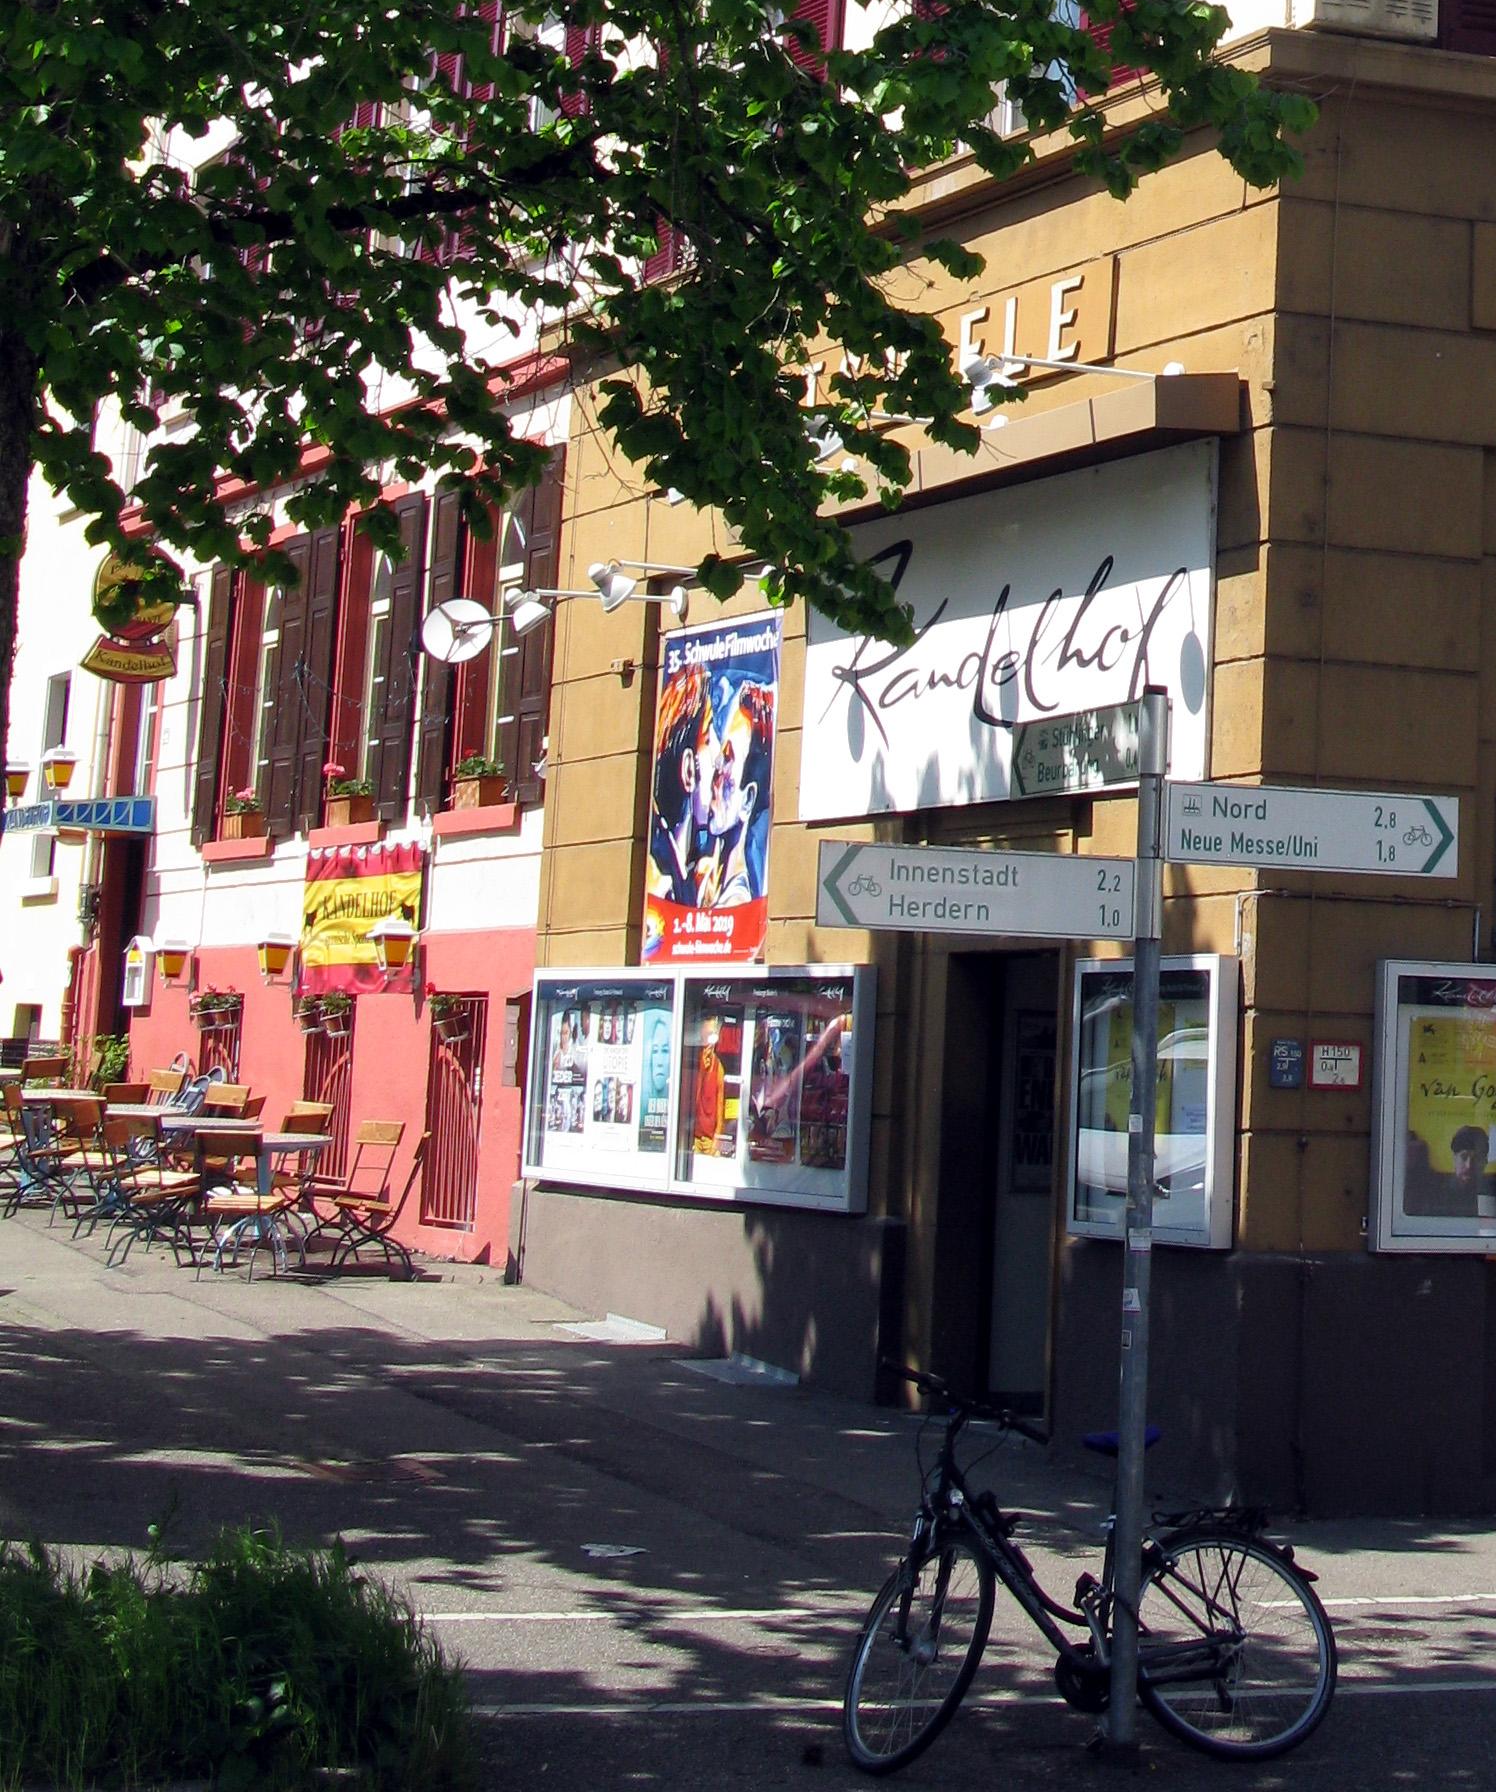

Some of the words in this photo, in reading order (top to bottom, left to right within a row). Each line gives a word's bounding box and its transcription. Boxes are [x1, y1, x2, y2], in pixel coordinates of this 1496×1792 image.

[684, 635, 725, 665] Schwule
[725, 625, 780, 658] Filmwoche
[818, 539, 1188, 751] Kandelhof
[1211, 796, 1267, 821] Nord
[1373, 806, 1397, 829] 2,8
[1180, 828, 1223, 852] Neue
[1230, 832, 1319, 859] Messe/Uni
[1376, 839, 1396, 863] 1,8
[889, 858, 1019, 888] Innenstadt
[1096, 869, 1121, 893] 2,2
[321, 890, 397, 921] KANDELHOF
[888, 894, 990, 921] Herdern
